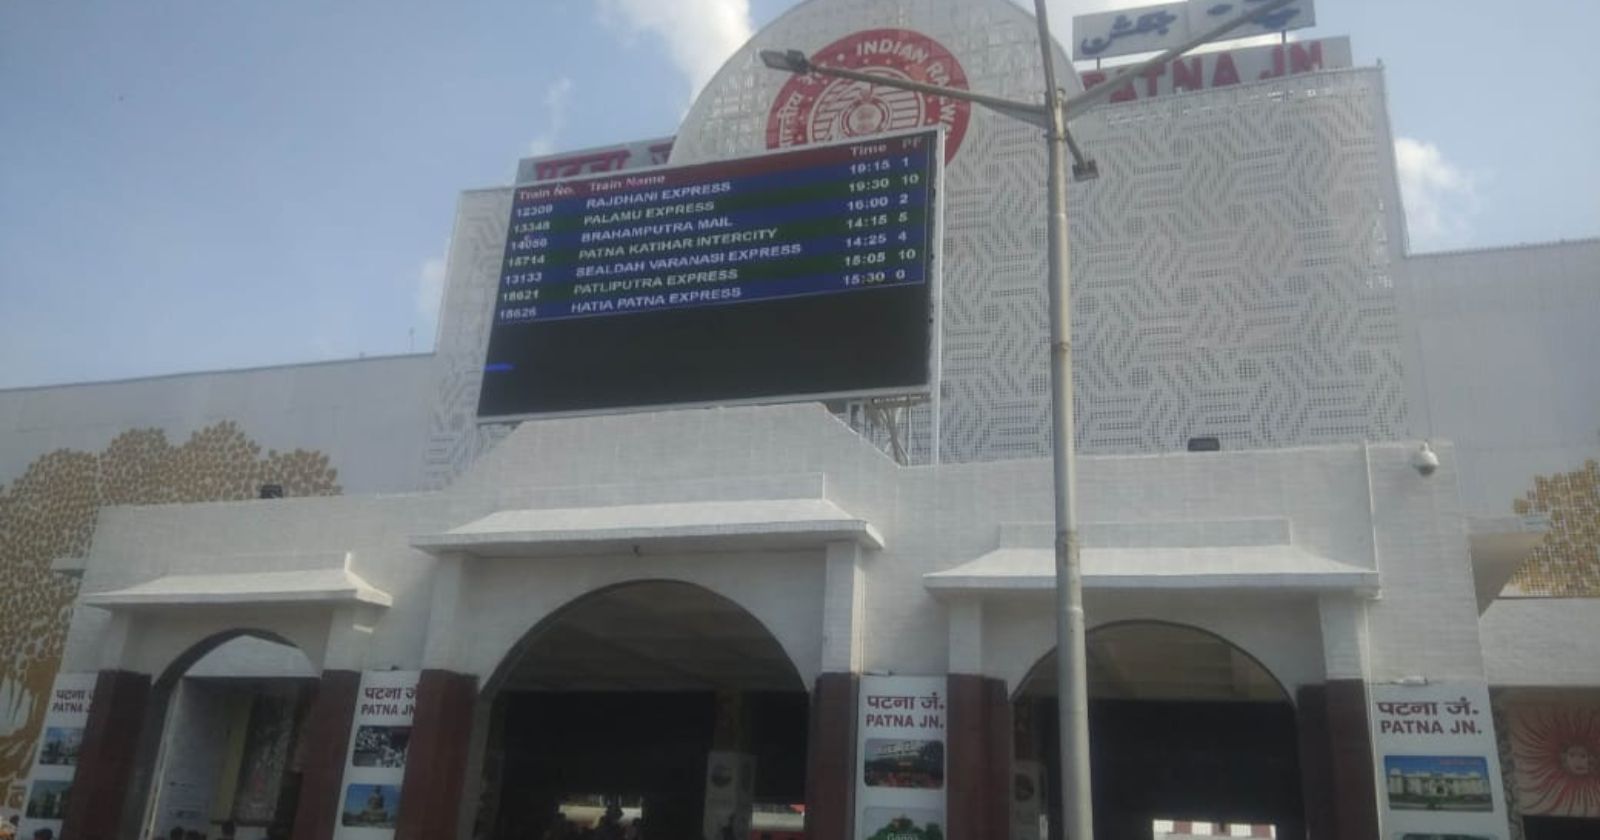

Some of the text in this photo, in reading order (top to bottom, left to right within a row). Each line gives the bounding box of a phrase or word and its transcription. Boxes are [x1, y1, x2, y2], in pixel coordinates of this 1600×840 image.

[856, 40, 928, 64] INDIAN
[520, 190, 550, 201] Train
[590, 181, 622, 192] Train
[626, 175, 665, 186] Name
[851, 143, 887, 156] Time
[586, 191, 658, 208] RAJDHANI
[662, 181, 731, 199] EXPRESS
[902, 156, 909, 168] 1
[583, 208, 642, 225] PALAMU
[645, 201, 715, 218] EXPRESS
[849, 178, 889, 193] 19:30
[901, 173, 919, 185] 10
[581, 222, 693, 243] BRAHAMPUTRA
[698, 216, 734, 230] MAIL
[847, 196, 889, 211] 16:00
[899, 193, 909, 205] 2
[578, 246, 624, 260] PATNA
[629, 238, 692, 254] KATIHAR
[696, 227, 779, 247] INTERCITY
[846, 213, 887, 229] 14:15
[898, 211, 908, 223] 5
[504, 229, 907, 285] 13133 SEALDAH VARANASI EXPRESS 14:25 4
[573, 276, 663, 295] PATLIPUTRA
[667, 269, 739, 286] EXPRESS
[844, 252, 885, 267] 15:05
[898, 248, 916, 261] 10
[571, 299, 614, 313] HATIA
[617, 295, 665, 311] PATNA
[669, 287, 742, 304] EXPRESS
[843, 271, 885, 286] 15:30
[895, 268, 906, 280] 0
[52, 702, 83, 713] PATNA
[360, 703, 398, 715] PATNA
[365, 687, 402, 699] पटना
[867, 695, 916, 710] पटना
[1376, 701, 1439, 716] पटना
[866, 714, 944, 729] PATNA JN.
[1380, 720, 1483, 735] PATNA JN.
